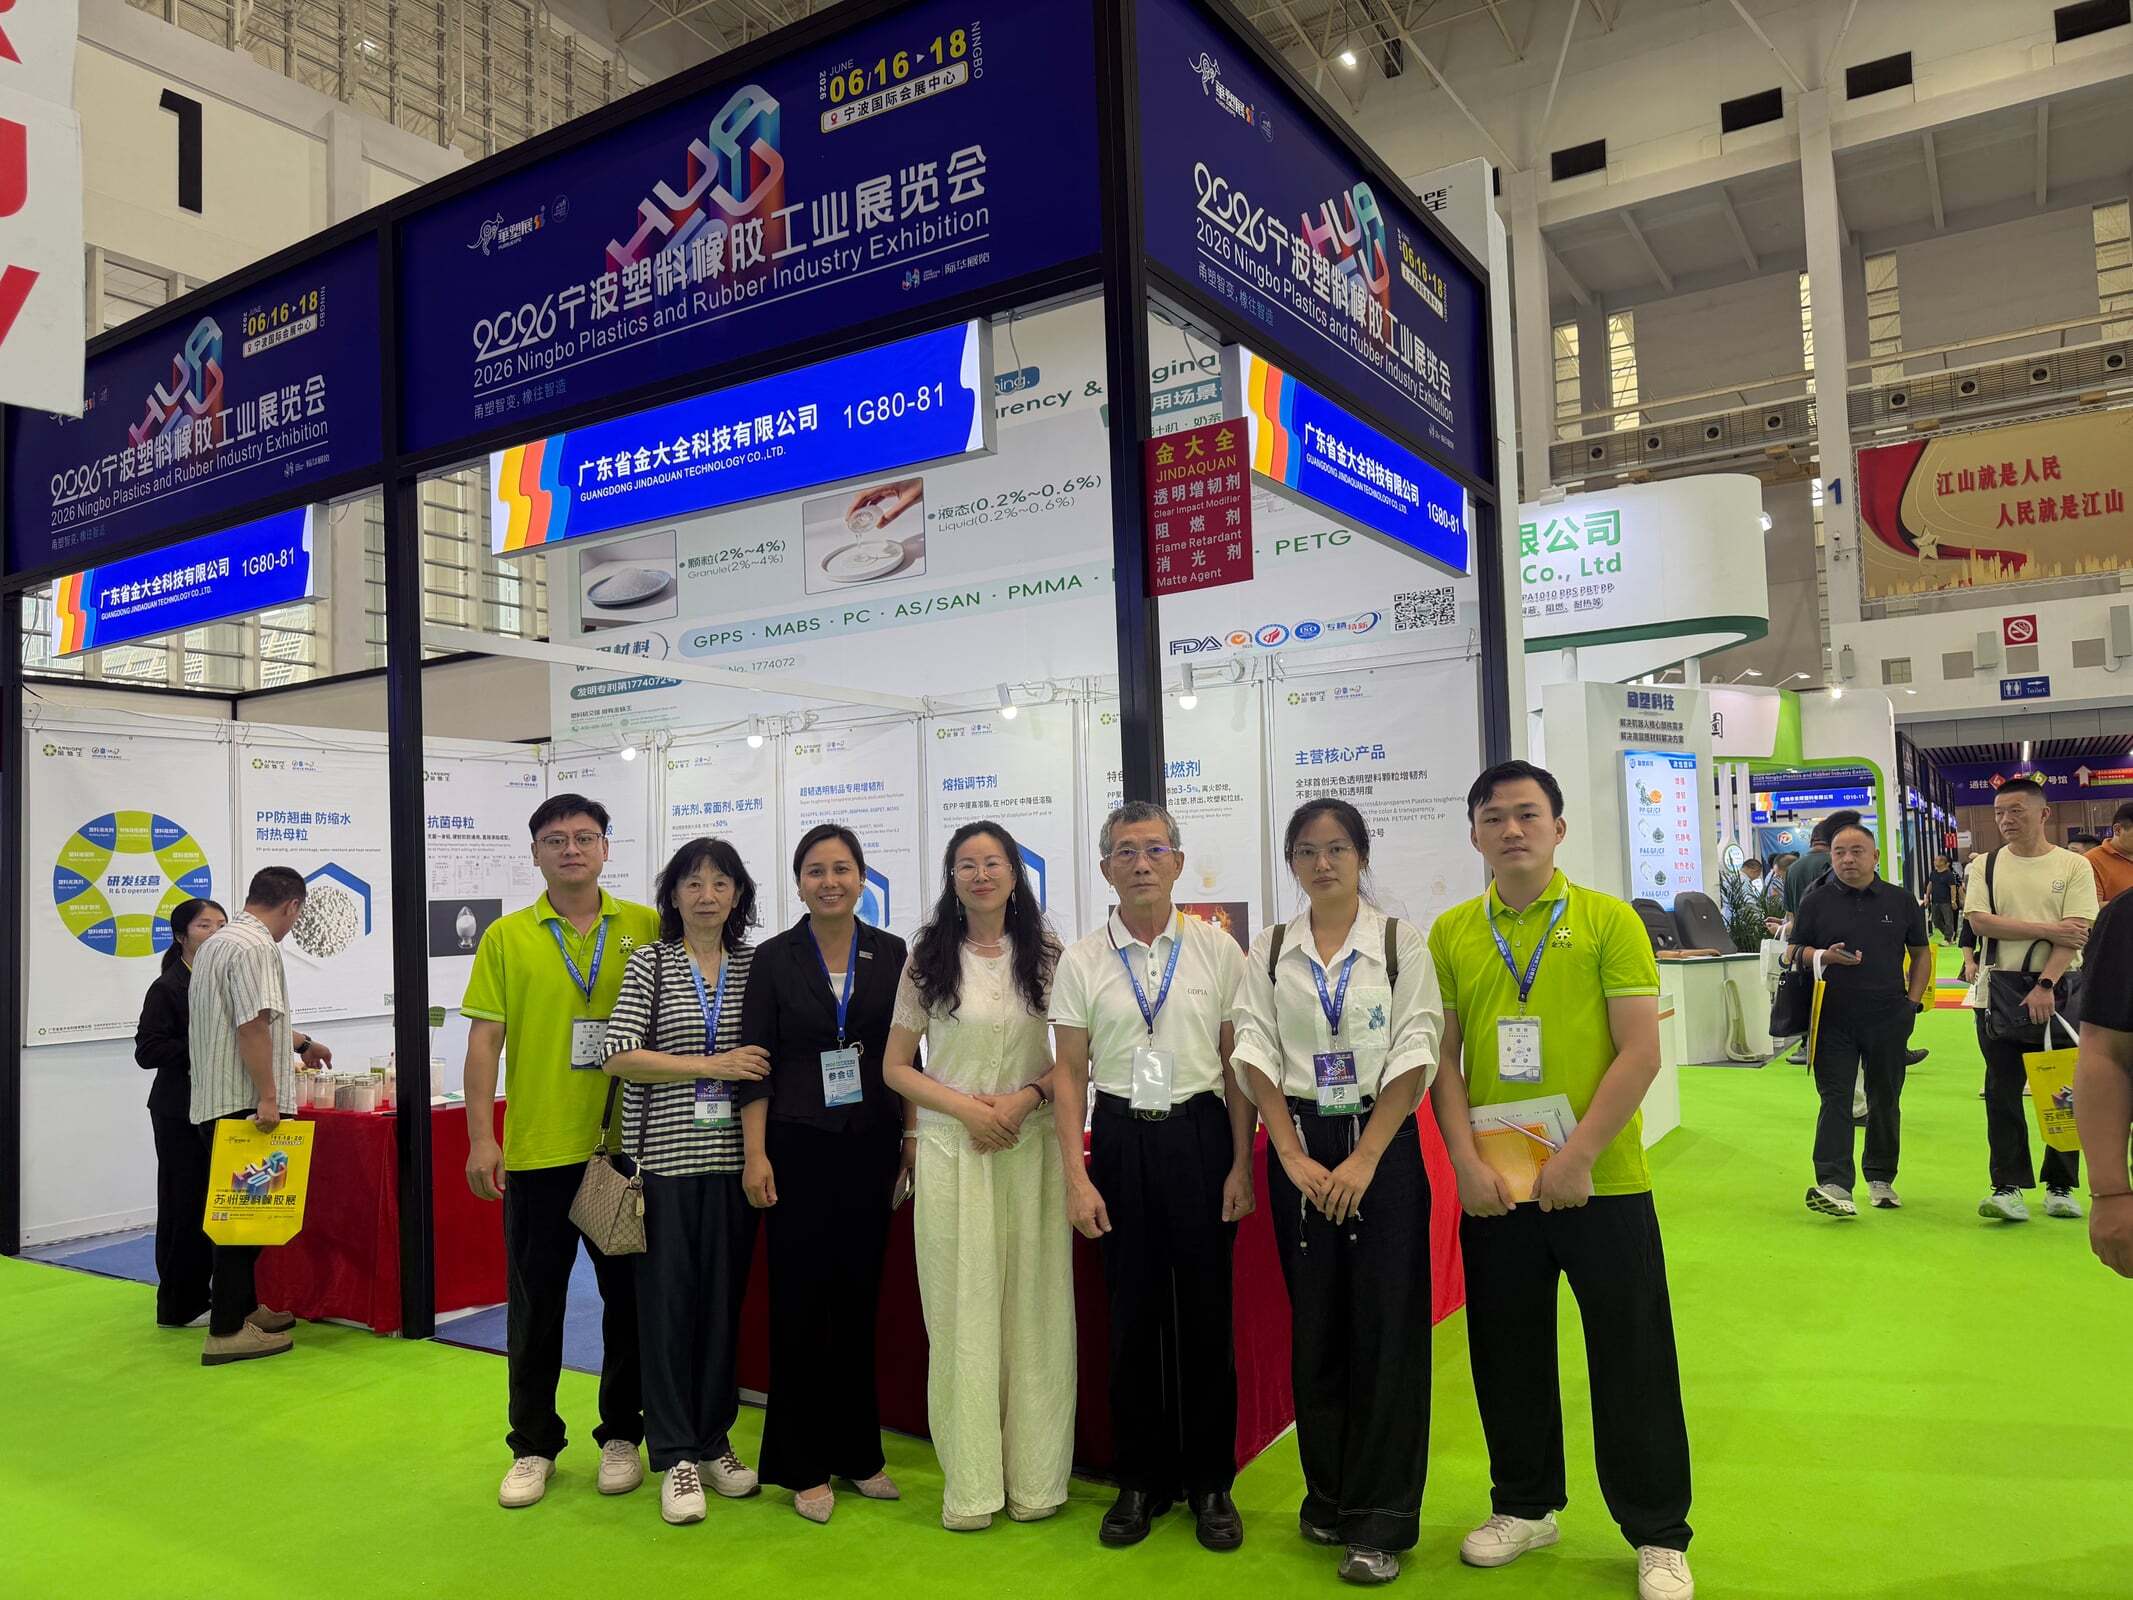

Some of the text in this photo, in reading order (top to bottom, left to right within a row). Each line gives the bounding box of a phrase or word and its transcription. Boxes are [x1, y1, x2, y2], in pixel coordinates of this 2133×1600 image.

[930, 28, 967, 64] 18
[971, 21, 984, 80] NINGBO
[829, 59, 855, 76] JUNE
[819, 71, 828, 101] 2026
[844, 71, 957, 121] 宁波国际会展中心
[472, 143, 987, 363] 2026宁波塑料橡胶工业展览会
[473, 208, 990, 388] 2026 Ningbo Plastics and Rubber Industry Exhibition
[1193, 162, 1453, 403] 2026宁波塑料橡胶工业展览会
[299, 290, 319, 316] 18
[1196, 217, 1454, 424] 2026 Ningbo Plastics and Rubber Industry Exhibition
[1083, 380, 1104, 398] &
[843, 382, 945, 429] 1G80-81
[50, 374, 327, 508] 2026宁波塑料橡胶工业展览会
[577, 403, 819, 487] 广东省金大全科技有限公司
[1155, 427, 1236, 466] 金大全
[51, 502, 76, 527] 2026
[77, 491, 112, 519] Ningbo
[112, 479, 152, 507] Plastics
[152, 472, 172, 492] and
[174, 458, 214, 484] Rubber
[216, 446, 263, 471] Industry
[266, 421, 329, 453] Exhibition
[580, 445, 787, 502] GUANGDONG JINDAQUAN TECHNOLOGY CO.,LTD.
[1156, 455, 1237, 484] JINDAQUAN
[1304, 421, 1420, 508] 广东省金大全科技有限公司
[1936, 455, 2062, 497] 江山就是人民
[1153, 472, 1240, 506] 透明增韧剂
[1827, 478, 1842, 505] 1
[1154, 494, 1241, 519] Clear Impact Modifier
[1426, 500, 1460, 536] 1G80-81
[1996, 488, 2124, 529] 人民就是江山
[1155, 507, 1240, 539] 阻燃剂
[1155, 530, 1243, 554] Flame Retardant
[241, 547, 295, 578] 1G80-81
[1156, 543, 1242, 574] 消光剂
[1580, 551, 1622, 577] Ltd
[100, 557, 230, 610] 广东省金大全科技有限公司
[694, 530, 1352, 648] GPPS MABS PC AS/SAN PMMA PETG
[1156, 567, 1222, 588] Matte Agent
[101, 606, 131, 621] GUANGDONG
[131, 600, 157, 614] JINDAQUAN
[157, 591, 192, 609] TECHNOLOGY
[1169, 635, 1222, 656] FDA
[751, 657, 796, 671] 1774072
[1295, 744, 1386, 766] 主营核心产品
[943, 774, 998, 791] 熔指调节剂
[256, 810, 352, 825] PP防翘曲 防缩水
[427, 816, 475, 829] 抗菌母粒
[256, 827, 309, 841] 耐热母粒
[107, 875, 161, 887] 研发经营
